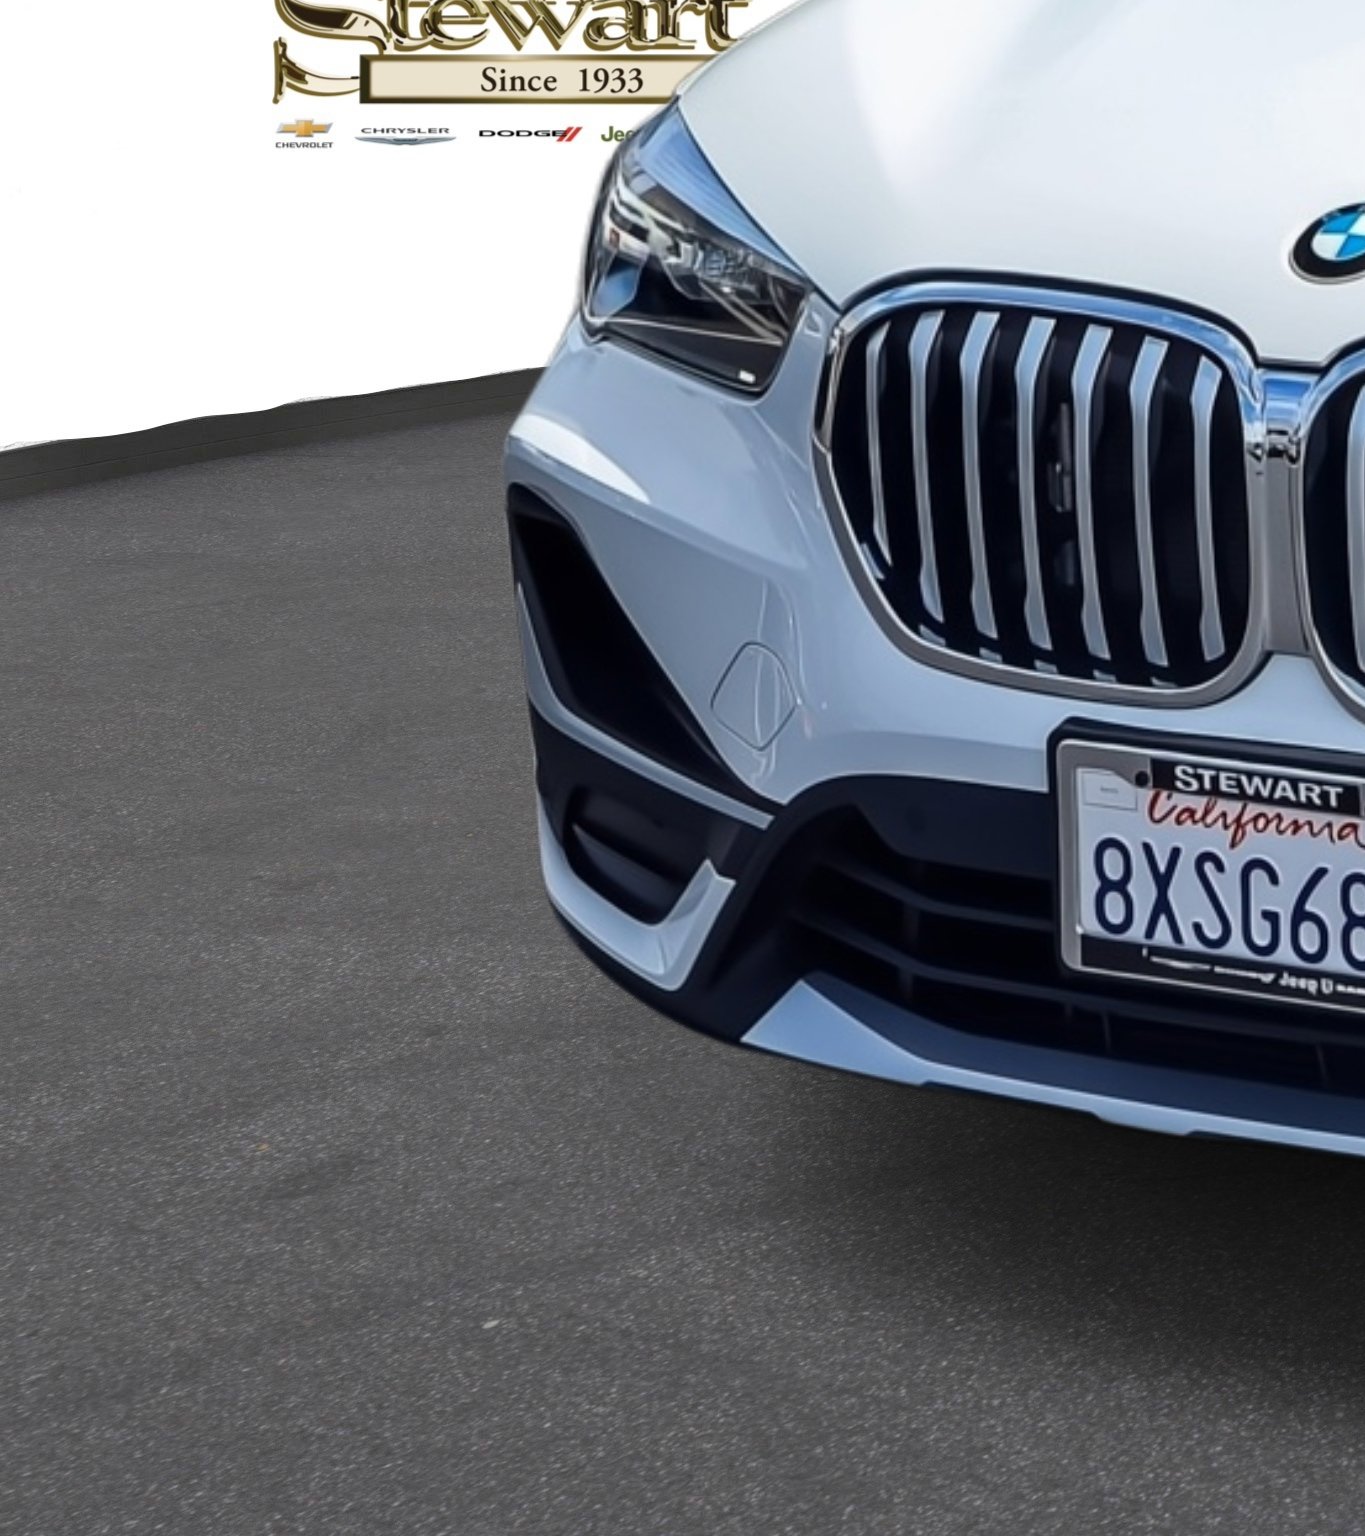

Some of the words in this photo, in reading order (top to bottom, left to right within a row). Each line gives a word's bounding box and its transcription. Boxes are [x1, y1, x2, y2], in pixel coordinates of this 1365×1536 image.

[480, 65, 557, 92] Since
[579, 66, 644, 93] 1933
[360, 126, 450, 134] CHRYSLER
[479, 129, 567, 137] DODGE
[1173, 765, 1344, 808] STEWART
